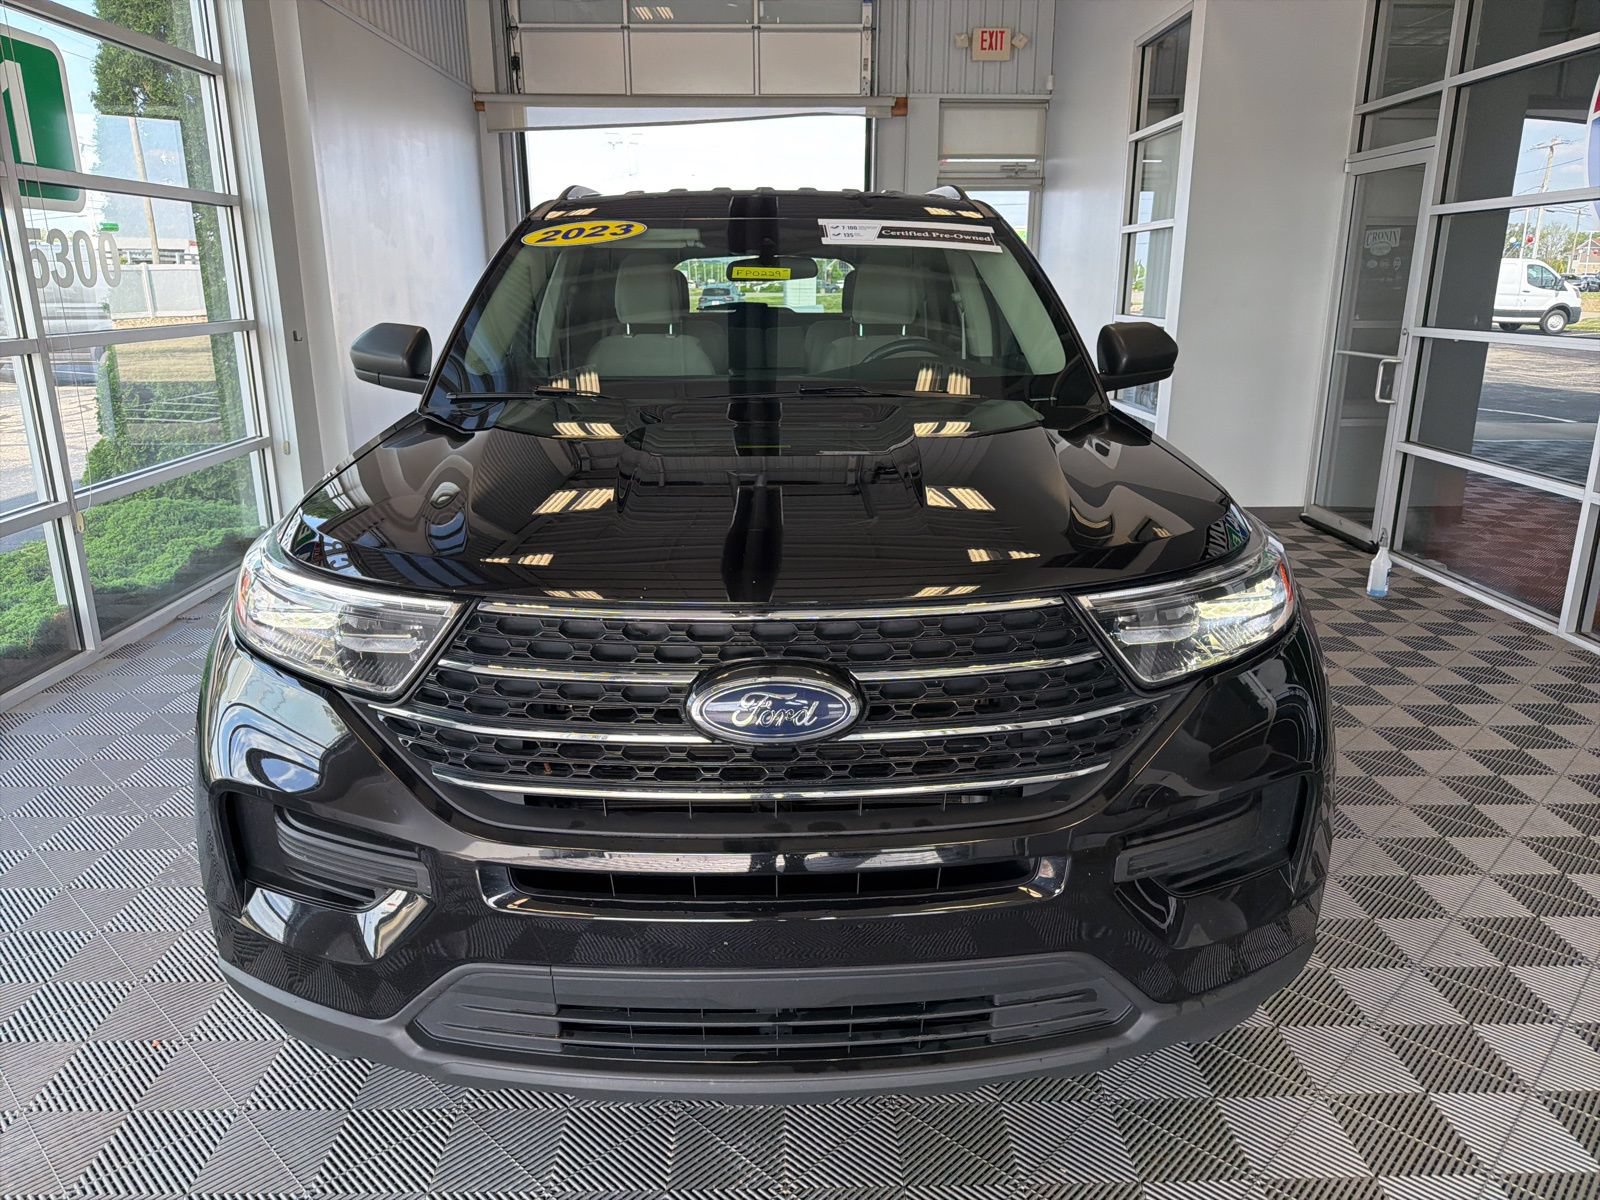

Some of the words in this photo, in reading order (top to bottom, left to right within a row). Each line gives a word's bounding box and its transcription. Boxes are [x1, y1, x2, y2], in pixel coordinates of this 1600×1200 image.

[980, 30, 1006, 51] EXIT
[534, 223, 635, 244] 2023
[881, 229, 929, 238] Certified
[931, 230, 992, 243] Pre-Owned
[26, 227, 122, 289] 5300
[731, 691, 819, 728] Ford
